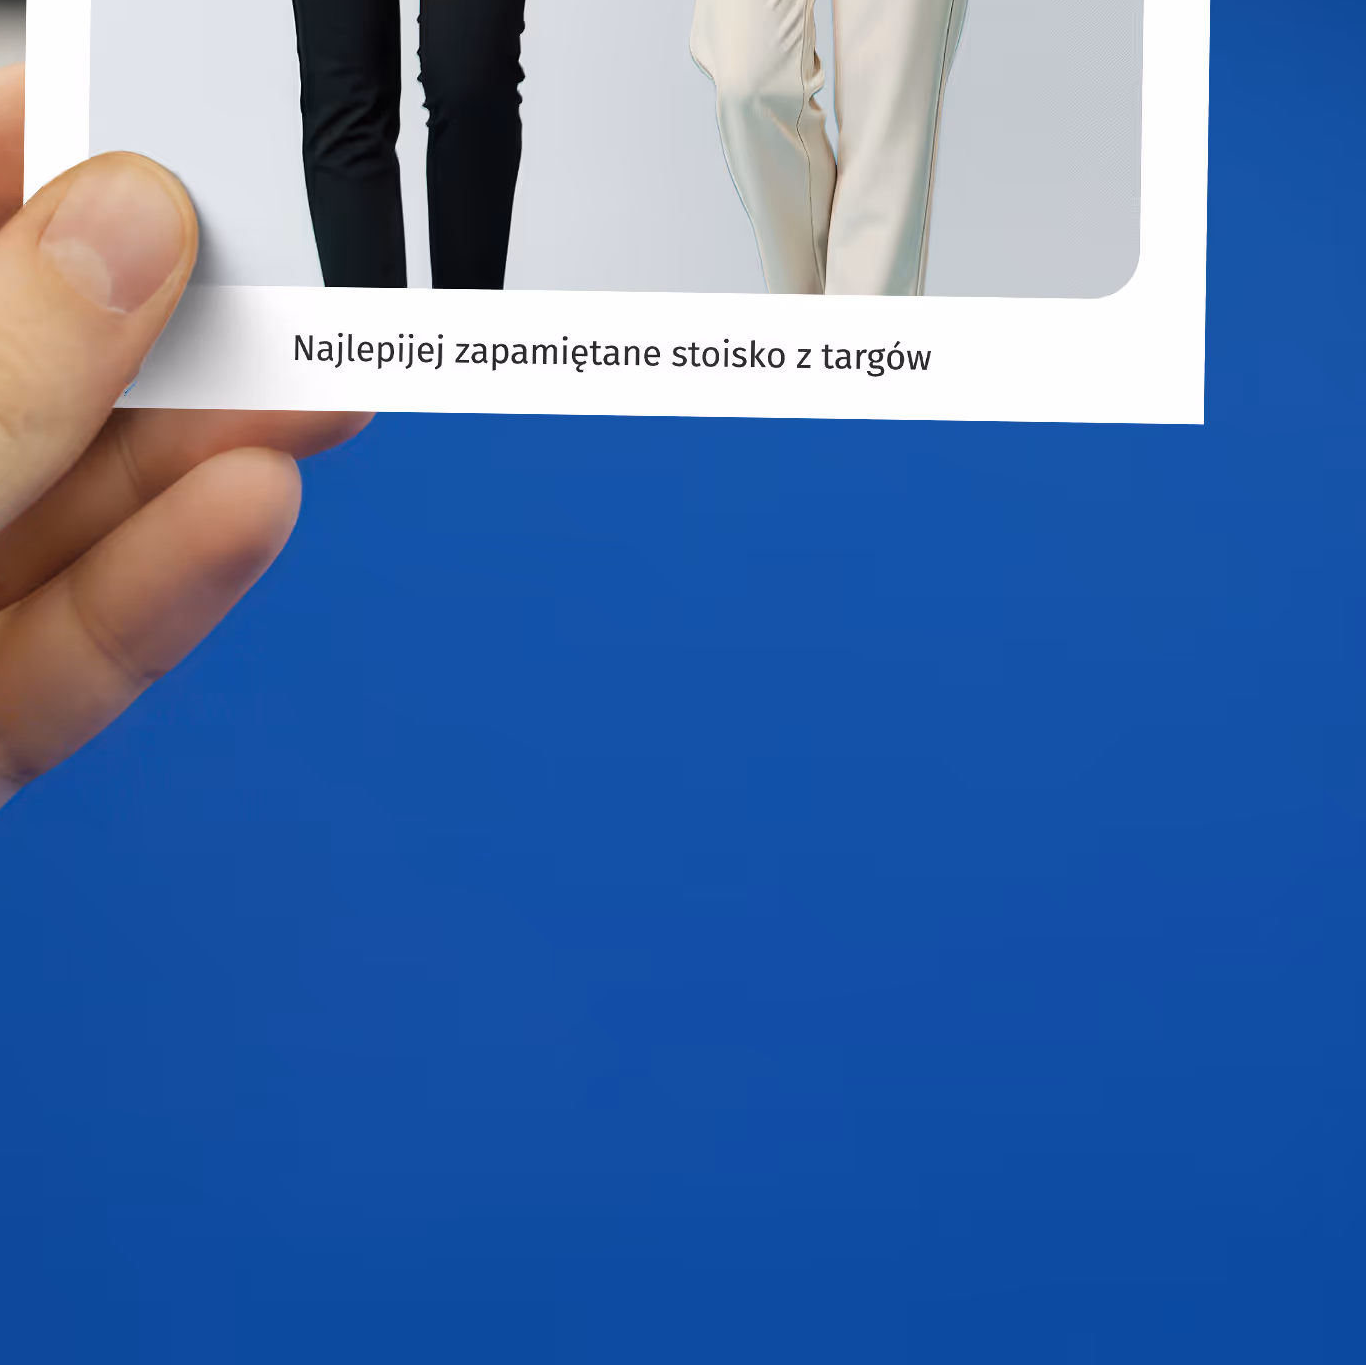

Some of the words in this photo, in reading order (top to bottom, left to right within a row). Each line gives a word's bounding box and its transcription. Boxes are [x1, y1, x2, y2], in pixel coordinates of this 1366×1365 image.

[293, 331, 444, 370] Najlepijej
[455, 335, 661, 373] zapamiętane
[671, 338, 786, 369] stoisko
[796, 348, 812, 369] z
[821, 340, 933, 378] targów
